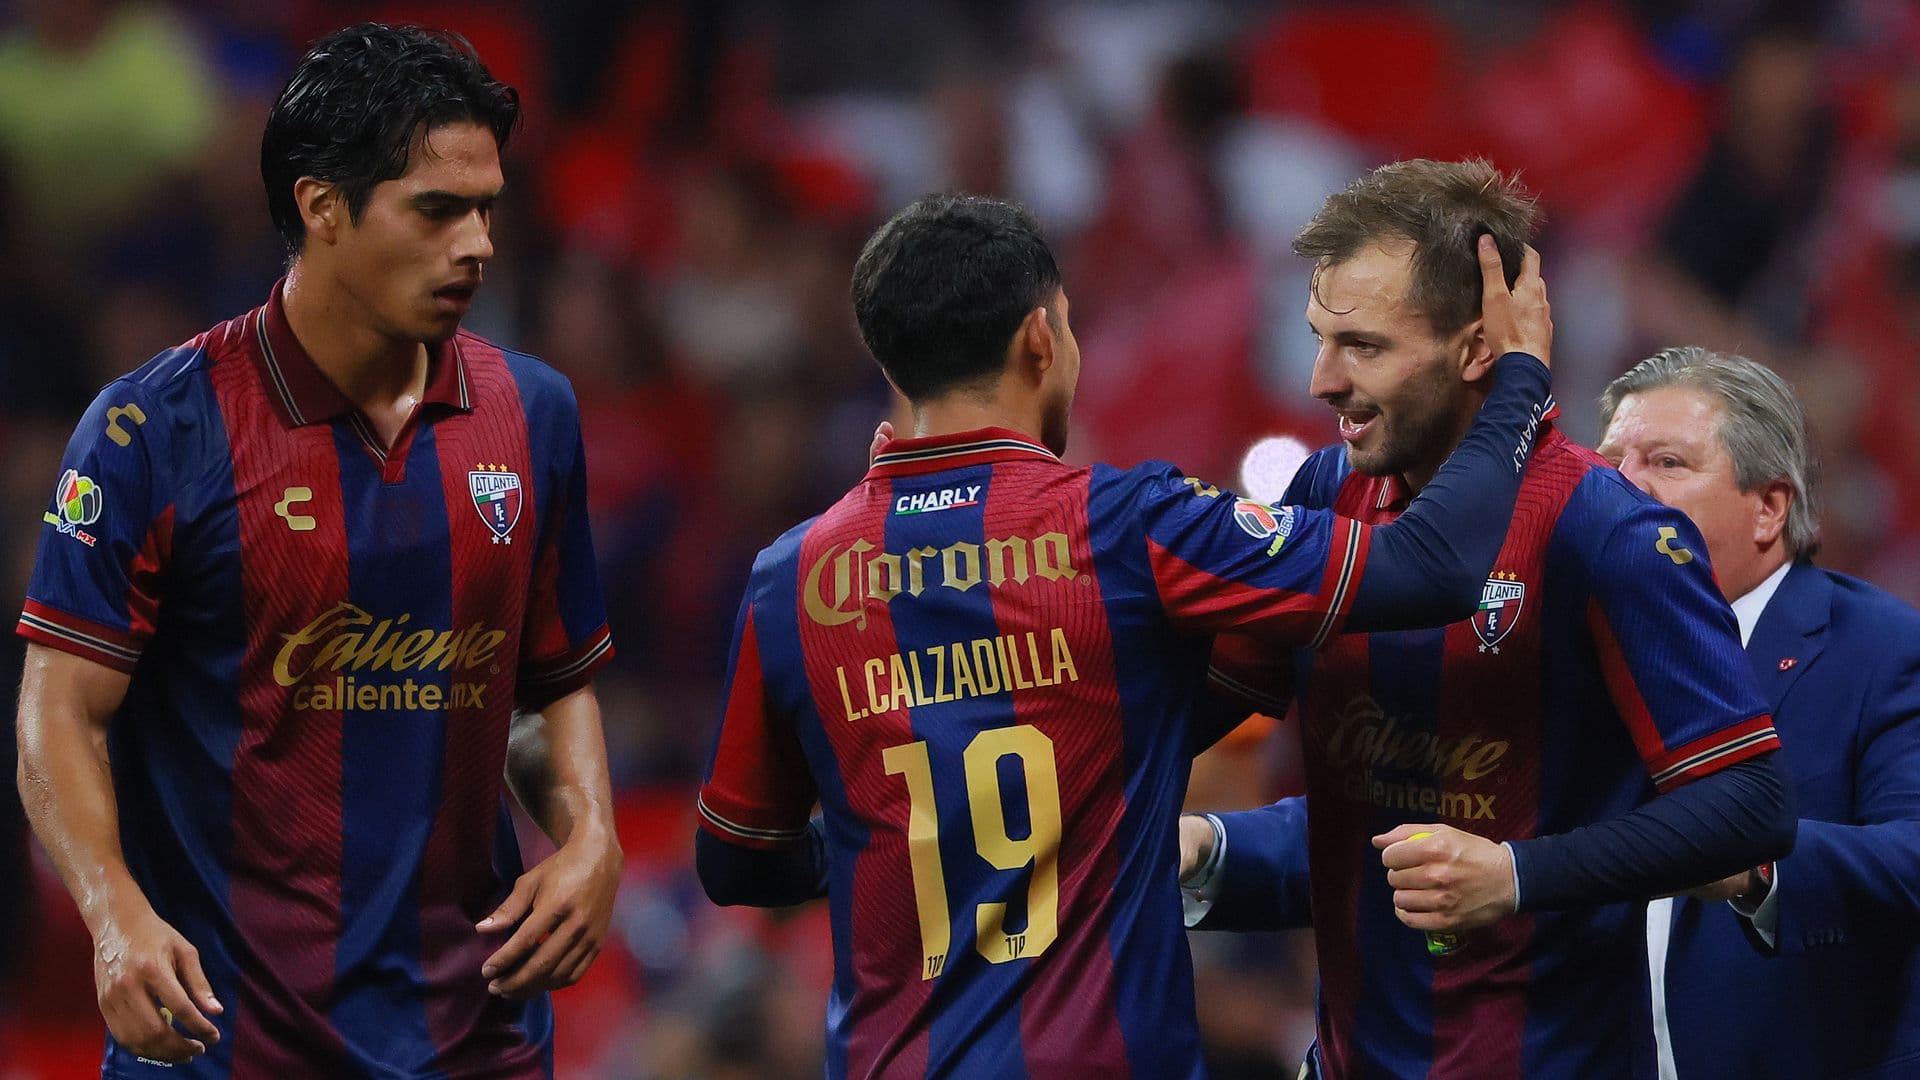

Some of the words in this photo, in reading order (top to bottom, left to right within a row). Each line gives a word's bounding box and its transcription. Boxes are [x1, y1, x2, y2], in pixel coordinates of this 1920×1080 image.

[1513, 403, 1542, 473] CHARLY
[475, 476, 518, 495] ATLANTE
[896, 486, 981, 512] CHARLY
[76, 530, 96, 547] MX
[804, 531, 1079, 631] Corona
[1483, 584, 1521, 600] TLANTE
[273, 602, 507, 687] Caliente
[293, 676, 487, 711] caliente.mx
[836, 628, 1079, 722] L.CALZADILLA
[882, 724, 1062, 981] 19
